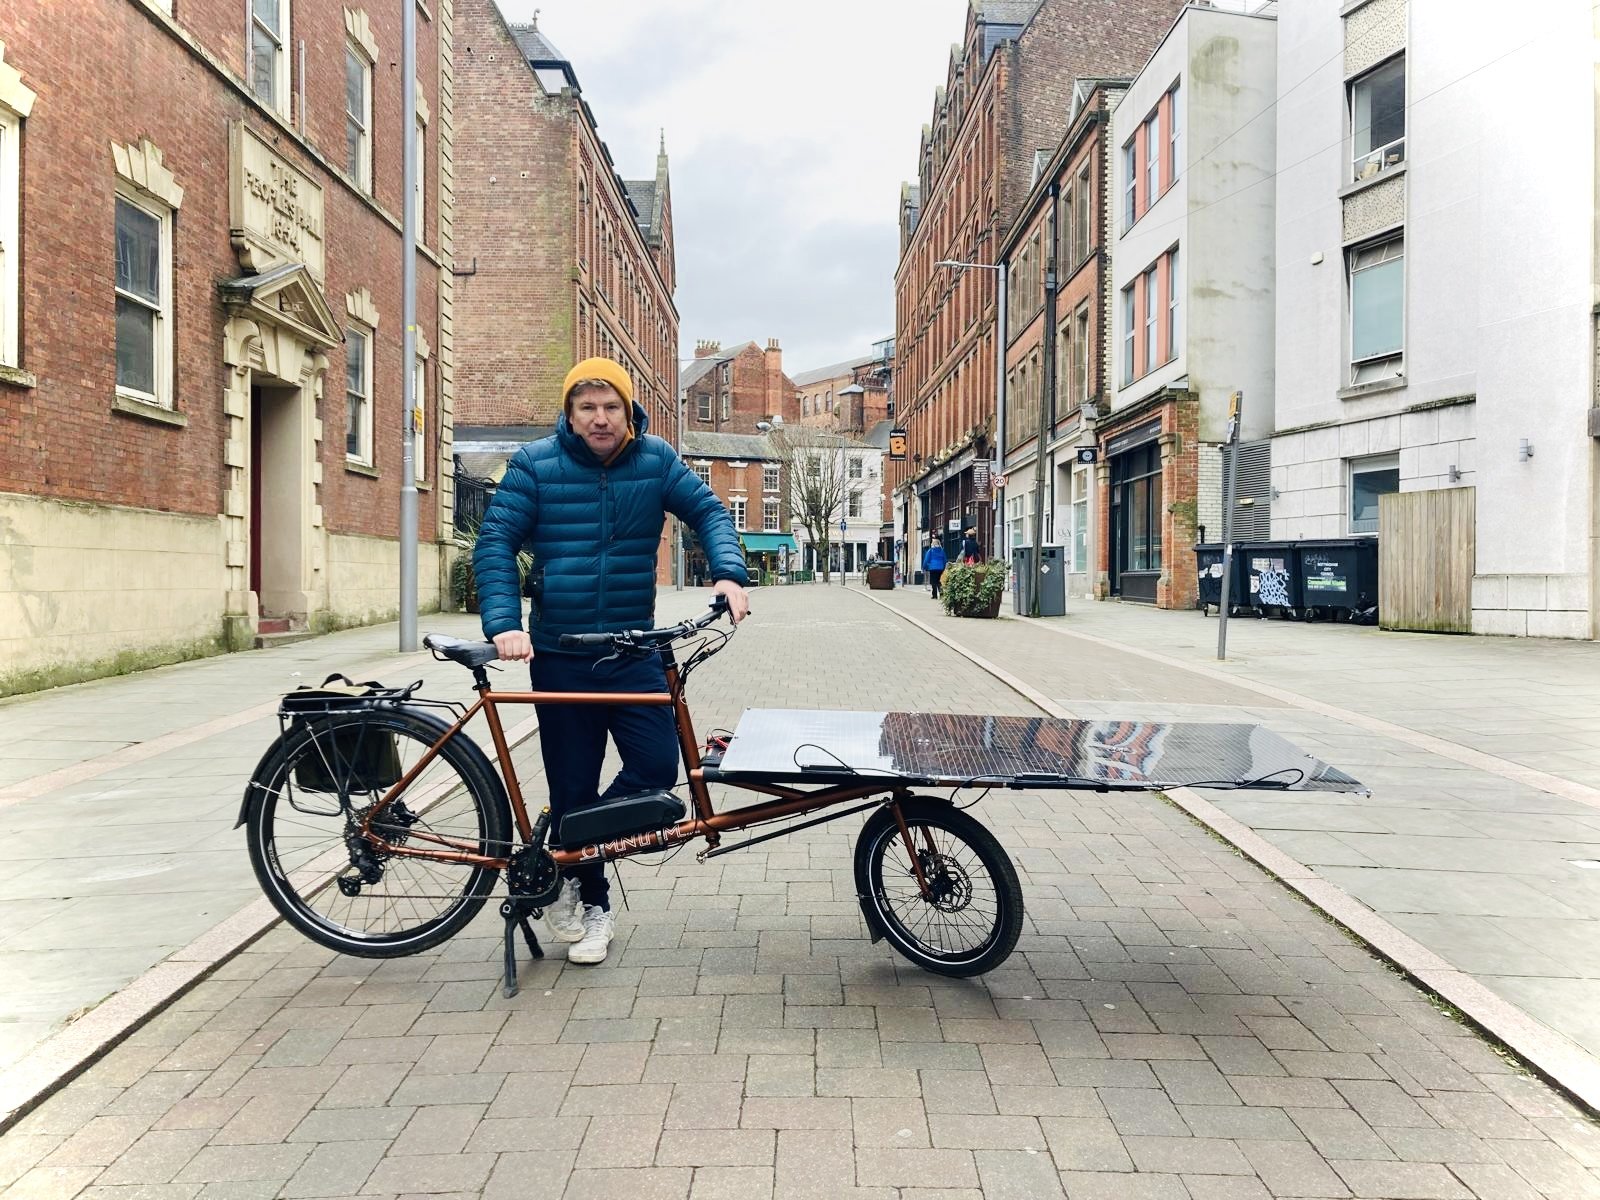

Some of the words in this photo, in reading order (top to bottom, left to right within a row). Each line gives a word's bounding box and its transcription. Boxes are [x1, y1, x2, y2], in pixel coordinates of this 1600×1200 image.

[270, 160, 297, 198] THE
[890, 437, 907, 455] B
[995, 477, 1005, 485] 20
